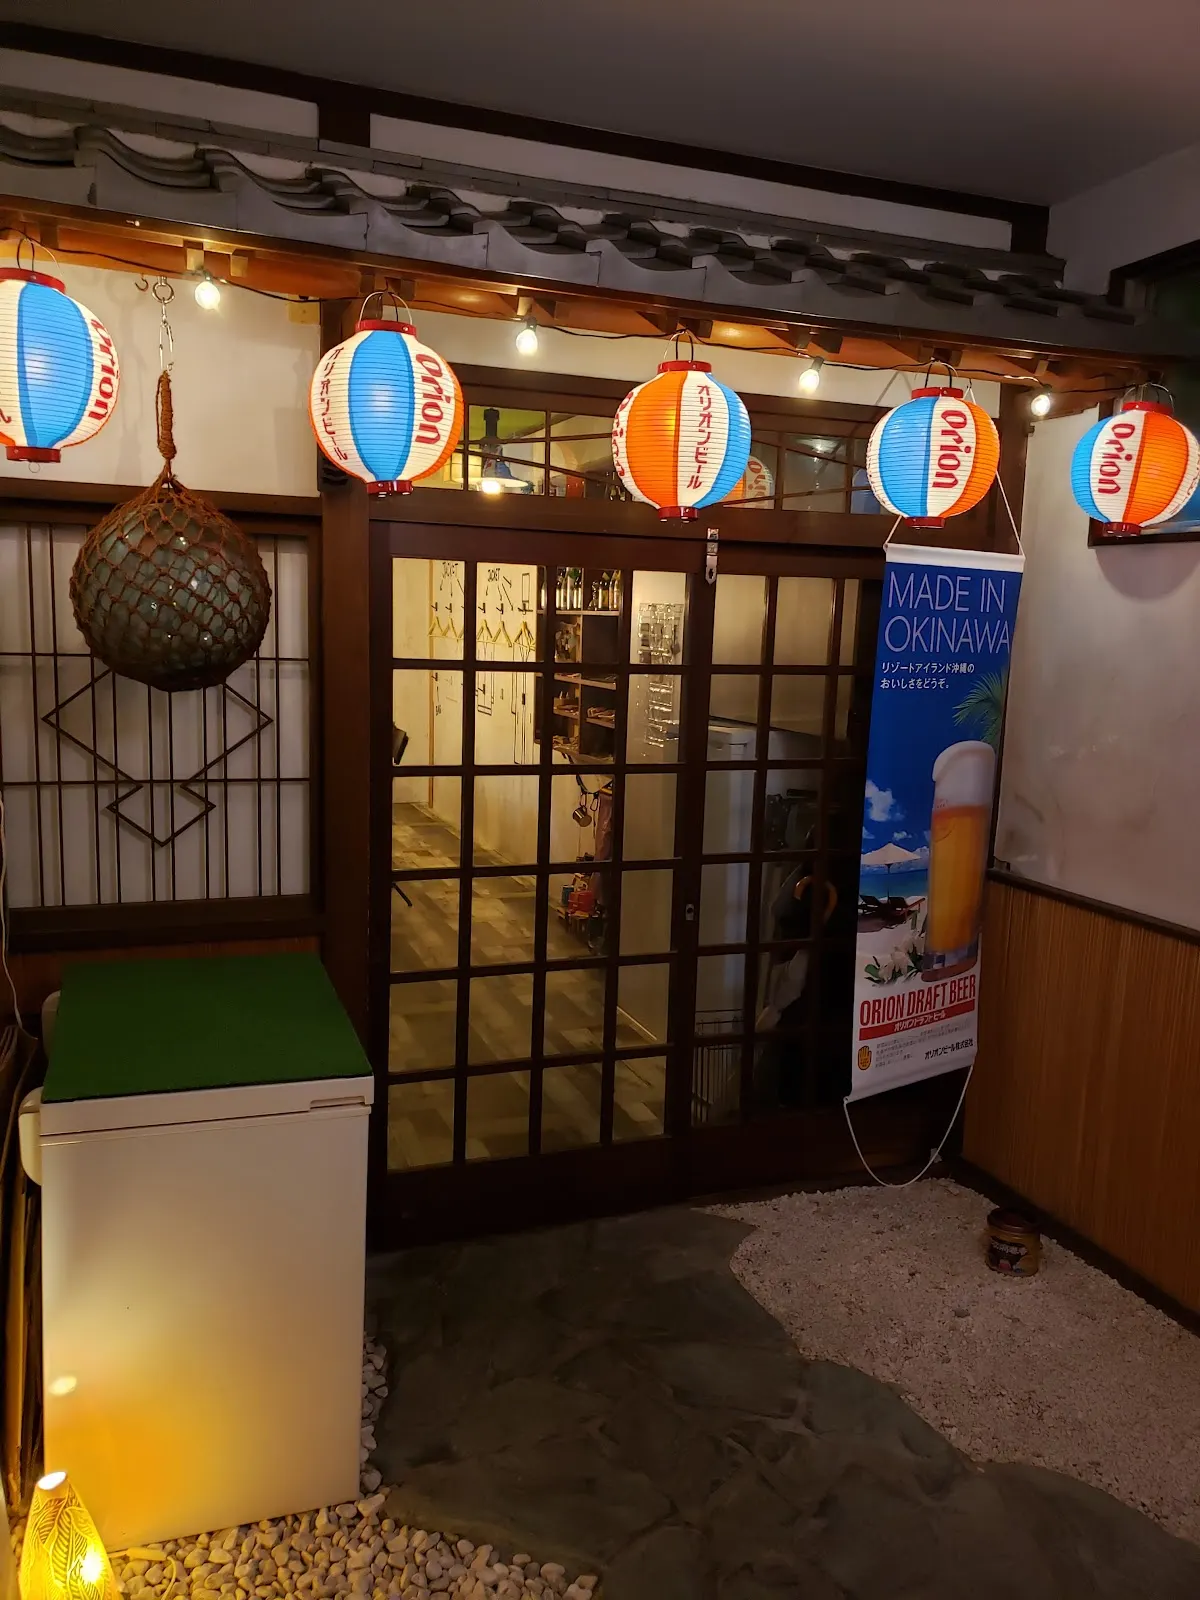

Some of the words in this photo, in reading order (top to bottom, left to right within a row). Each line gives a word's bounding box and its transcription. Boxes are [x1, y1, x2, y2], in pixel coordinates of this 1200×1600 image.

[88, 318, 121, 421] Orion
[320, 346, 348, 461] オリオンビール
[415, 353, 452, 445] Orion
[686, 385, 714, 489] オリオンビール
[931, 409, 972, 489] Orion
[1097, 422, 1136, 495] Orion
[888, 571, 972, 612] MADE
[980, 577, 1006, 614] IN
[881, 662, 975, 674] リゾートアイランド沖縄の
[884, 615, 1011, 654] OKINAWA
[880, 677, 951, 690] おいしさをどうぞ。
[860, 993, 905, 1027] ORION
[907, 982, 948, 1017] DRAFT
[949, 974, 976, 1005] BEER
